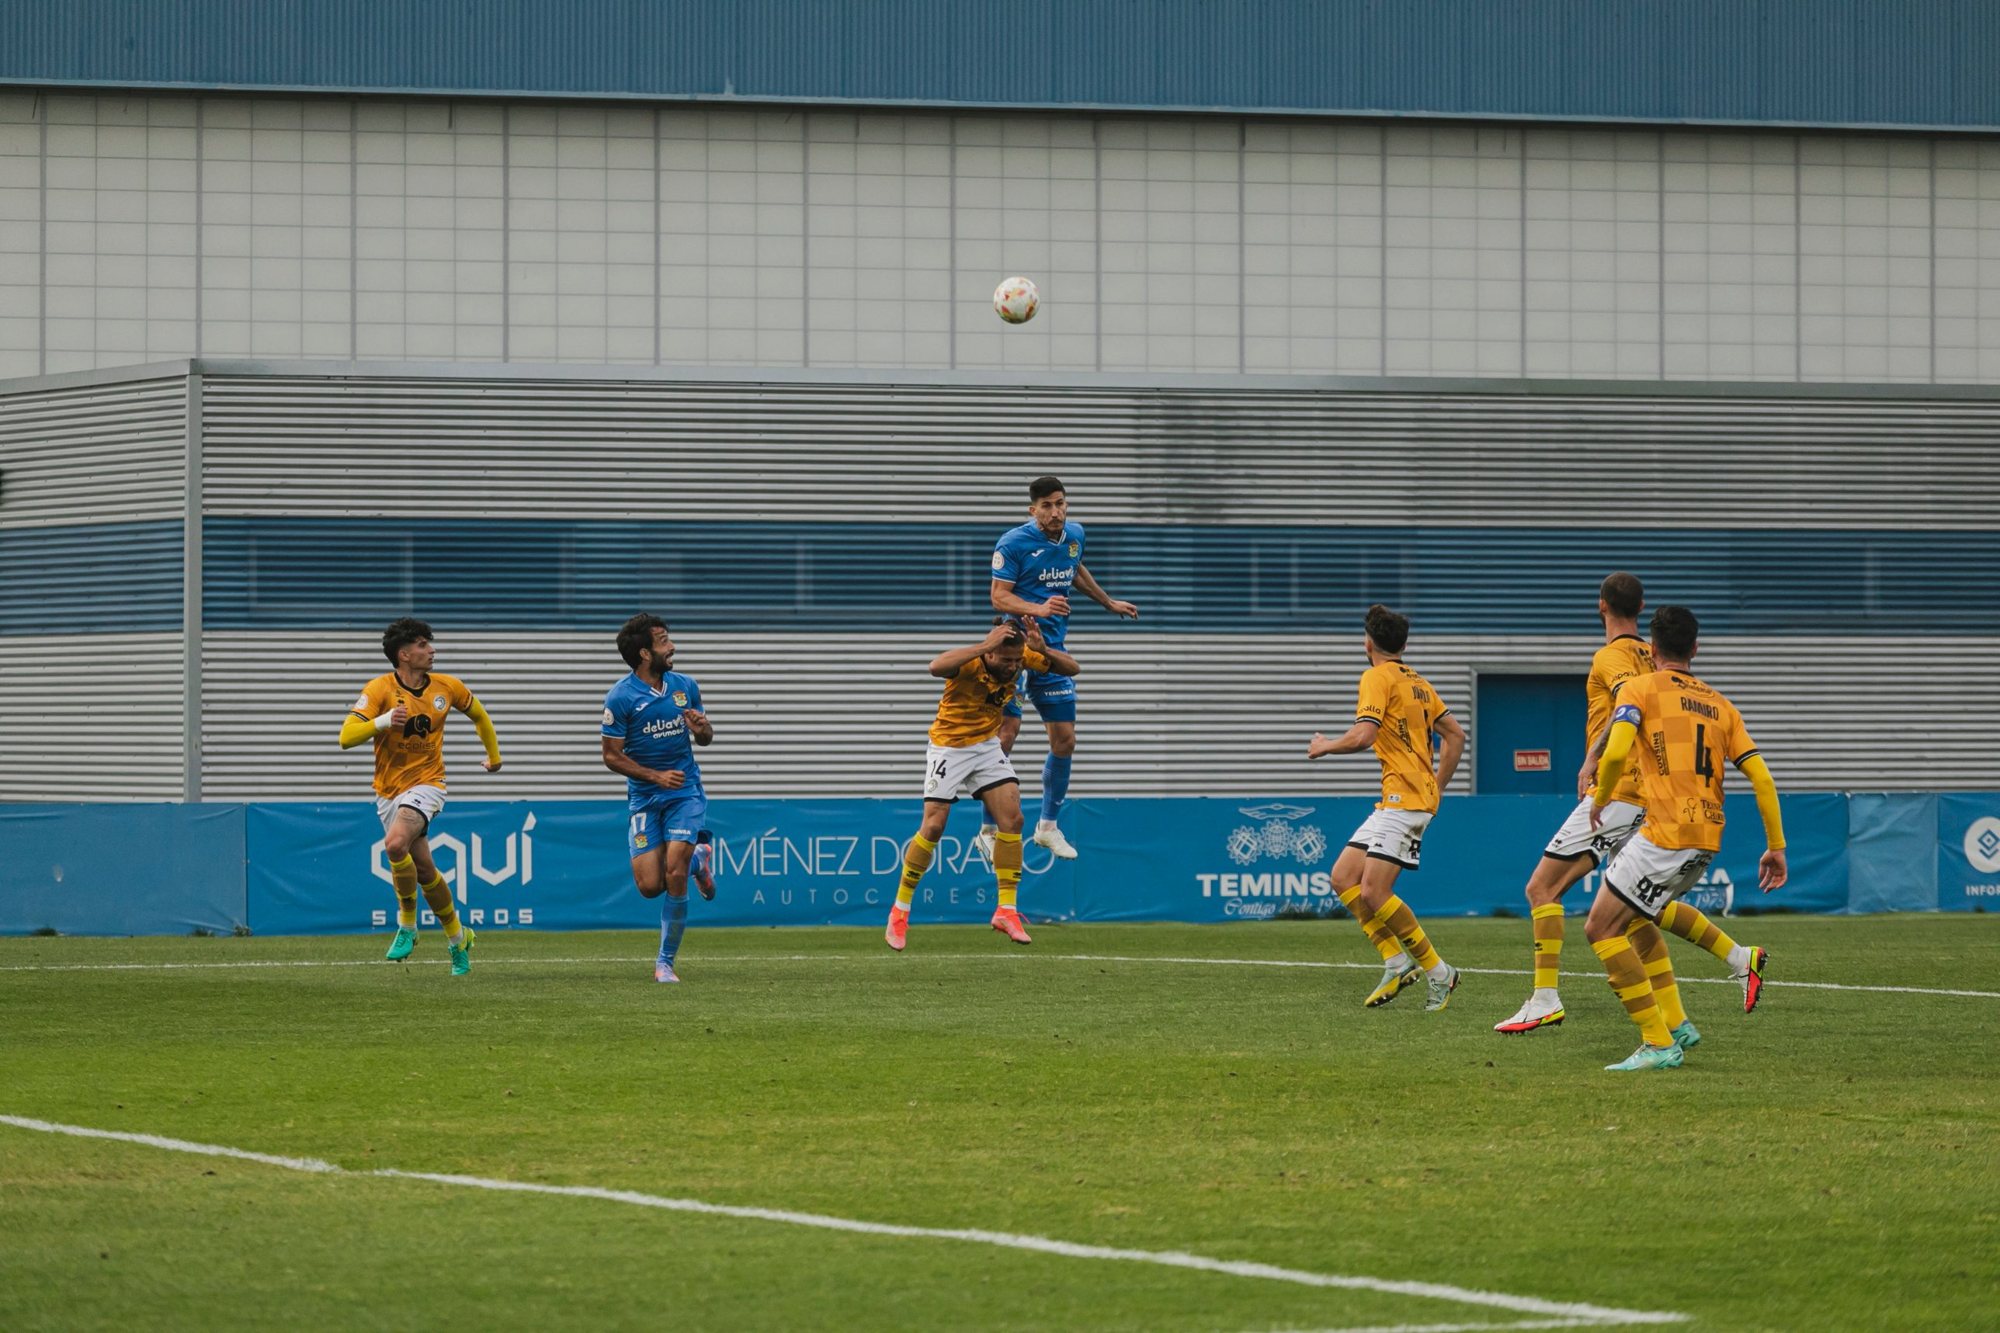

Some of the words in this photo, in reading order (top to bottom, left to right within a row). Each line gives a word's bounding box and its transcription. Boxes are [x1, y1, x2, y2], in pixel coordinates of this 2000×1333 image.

[1680, 696, 1719, 721] RAMIRO
[1695, 723, 1714, 788] 4
[930, 759, 947, 779] 14
[630, 812, 647, 835] 17
[871, 836, 1056, 875] DORAO
[753, 888, 986, 904] AUTOCRES
[1196, 872, 1340, 897] TEMINS
[372, 908, 533, 926] SGROS
